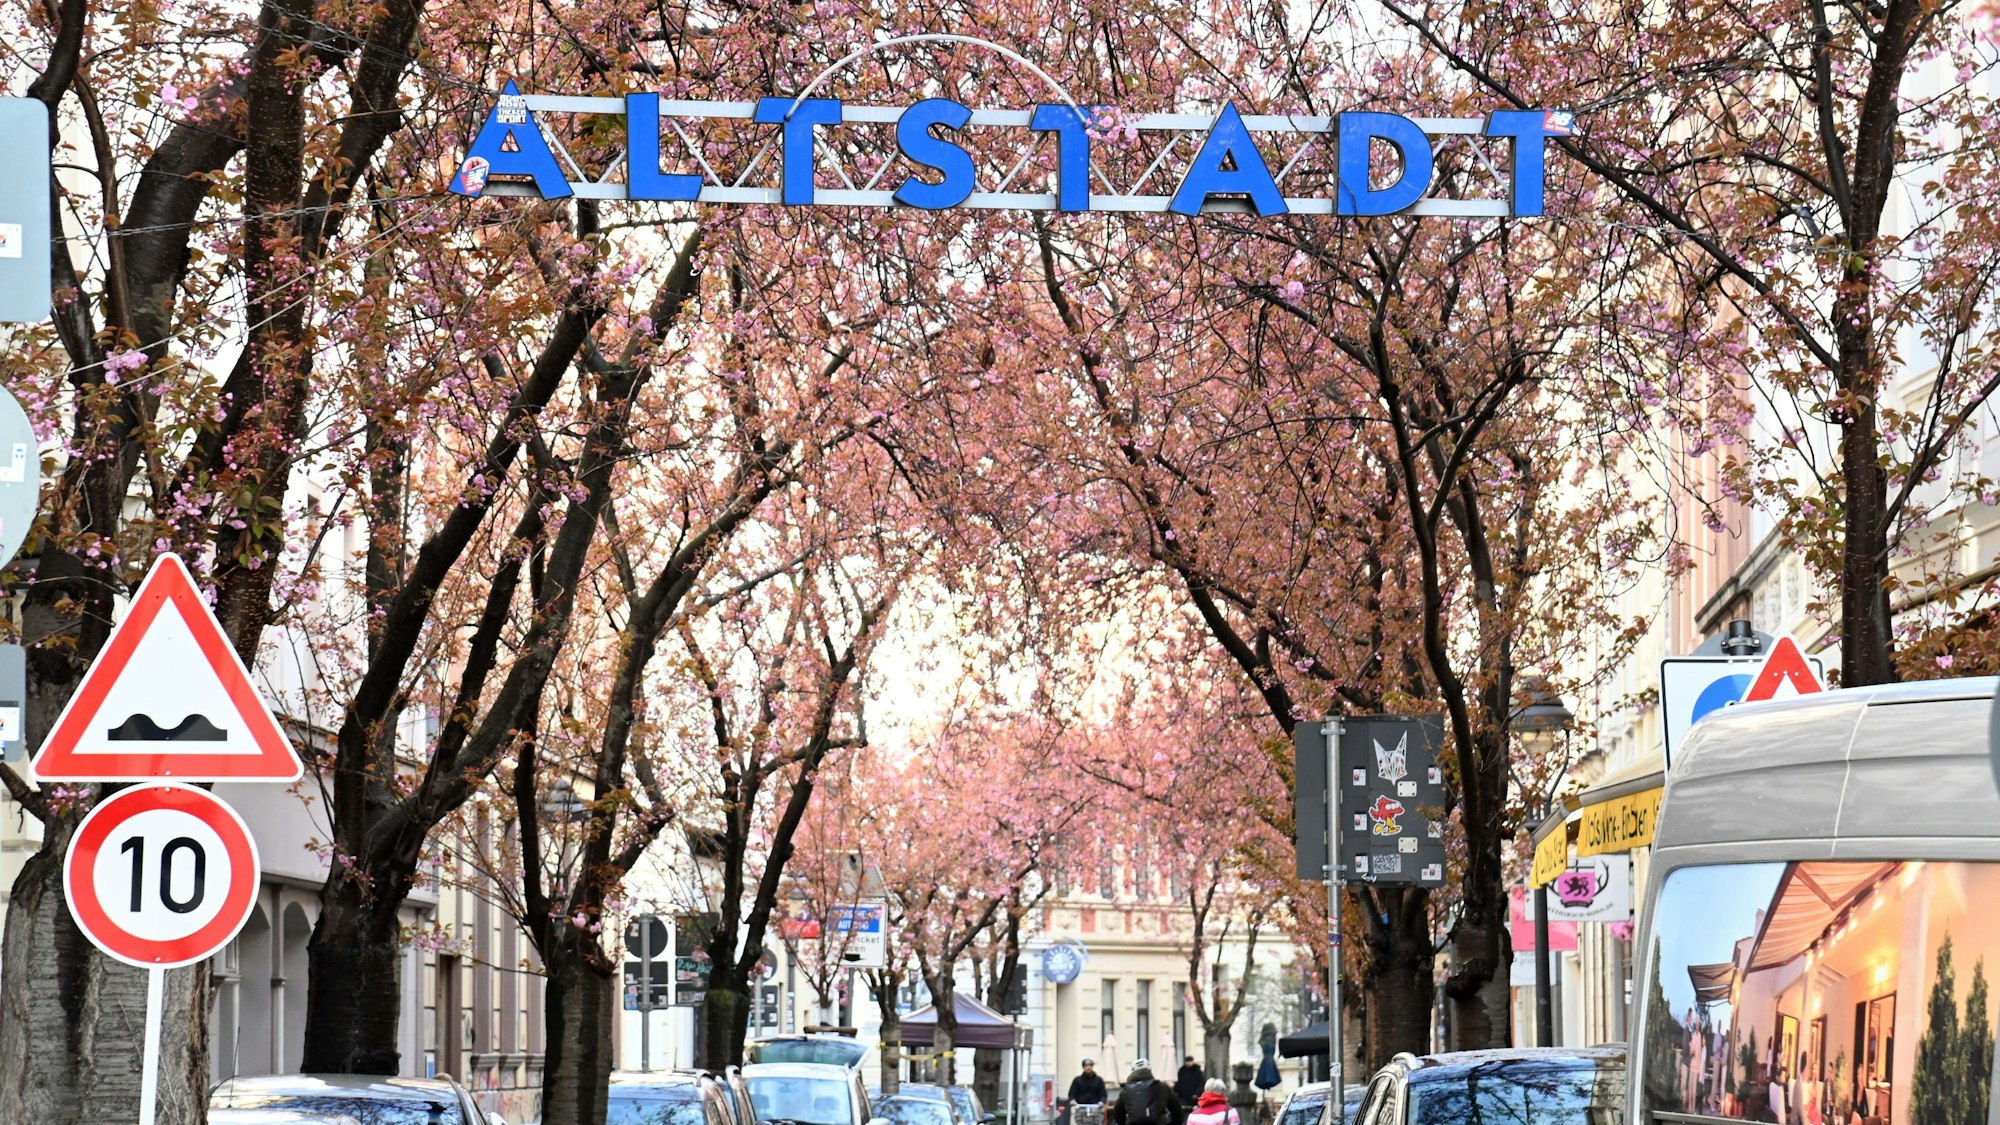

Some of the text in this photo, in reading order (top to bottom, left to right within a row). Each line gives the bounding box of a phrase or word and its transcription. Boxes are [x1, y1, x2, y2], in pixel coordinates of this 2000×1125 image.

[448, 77, 1573, 217] ALTSTADT
[497, 114, 527, 123] SPORT
[121, 836, 206, 914] 10
